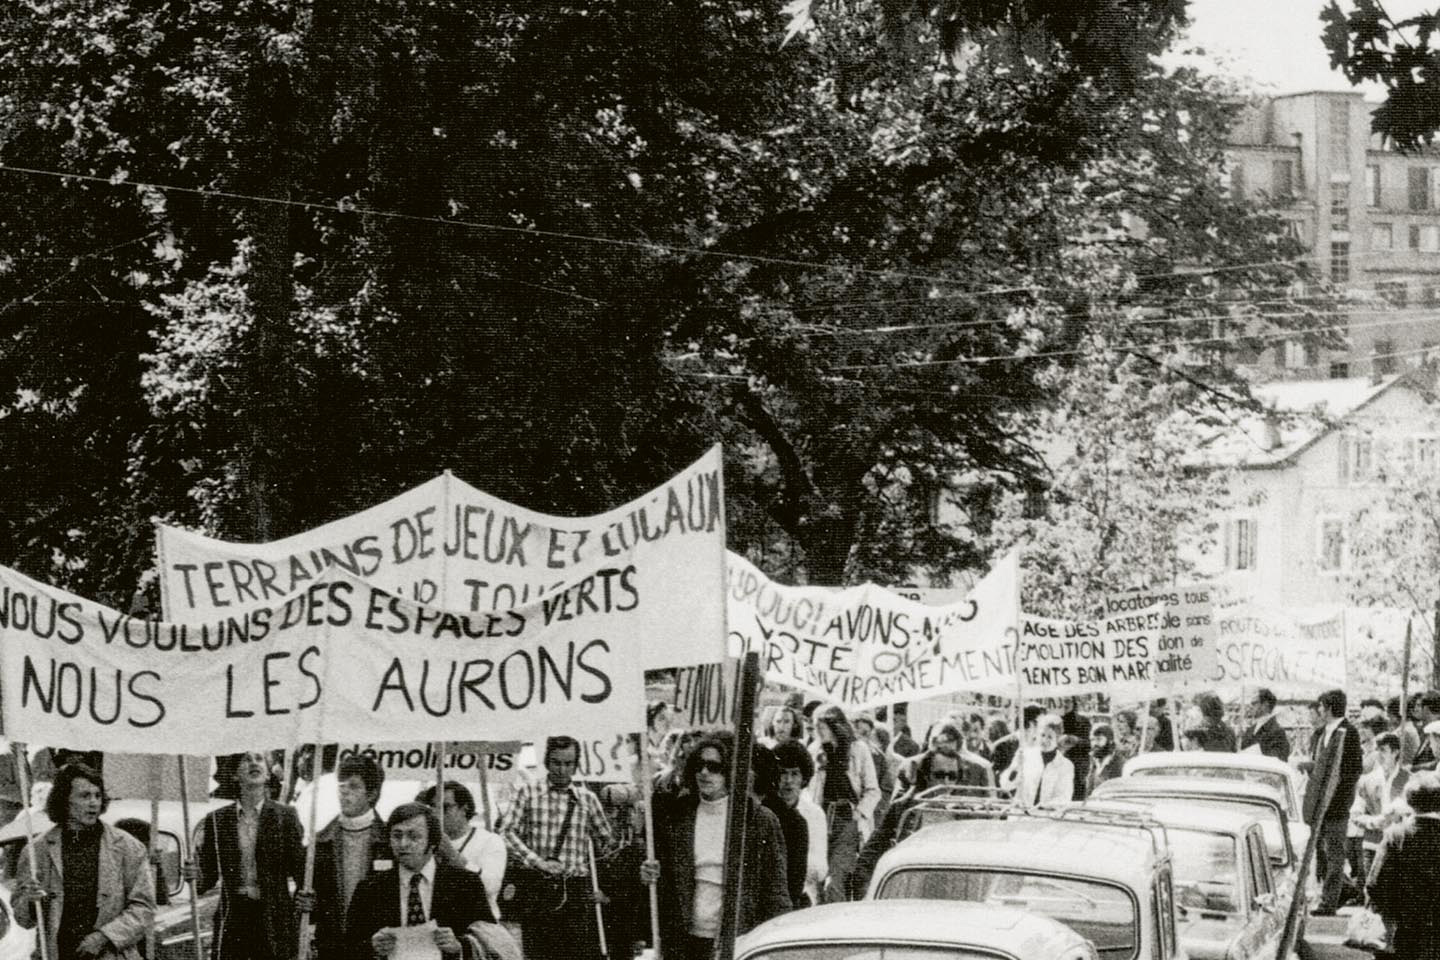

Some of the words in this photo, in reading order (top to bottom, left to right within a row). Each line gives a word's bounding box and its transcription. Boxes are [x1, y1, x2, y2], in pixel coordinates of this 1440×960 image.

[173, 535, 383, 608] TERRAINS
[391, 505, 436, 565] DE
[444, 504, 532, 567] JEUX
[547, 527, 591, 568] ET
[278, 580, 354, 631] DES
[542, 564, 639, 626] VERTS
[1021, 639, 1106, 662] MOLITION
[1114, 635, 1149, 659] DES
[1022, 620, 1060, 639] AGE
[1065, 622, 1101, 638] DES
[21, 654, 166, 728] NOUS
[225, 645, 322, 719] LES
[372, 638, 613, 718] AURONS
[1078, 664, 1108, 684] BON
